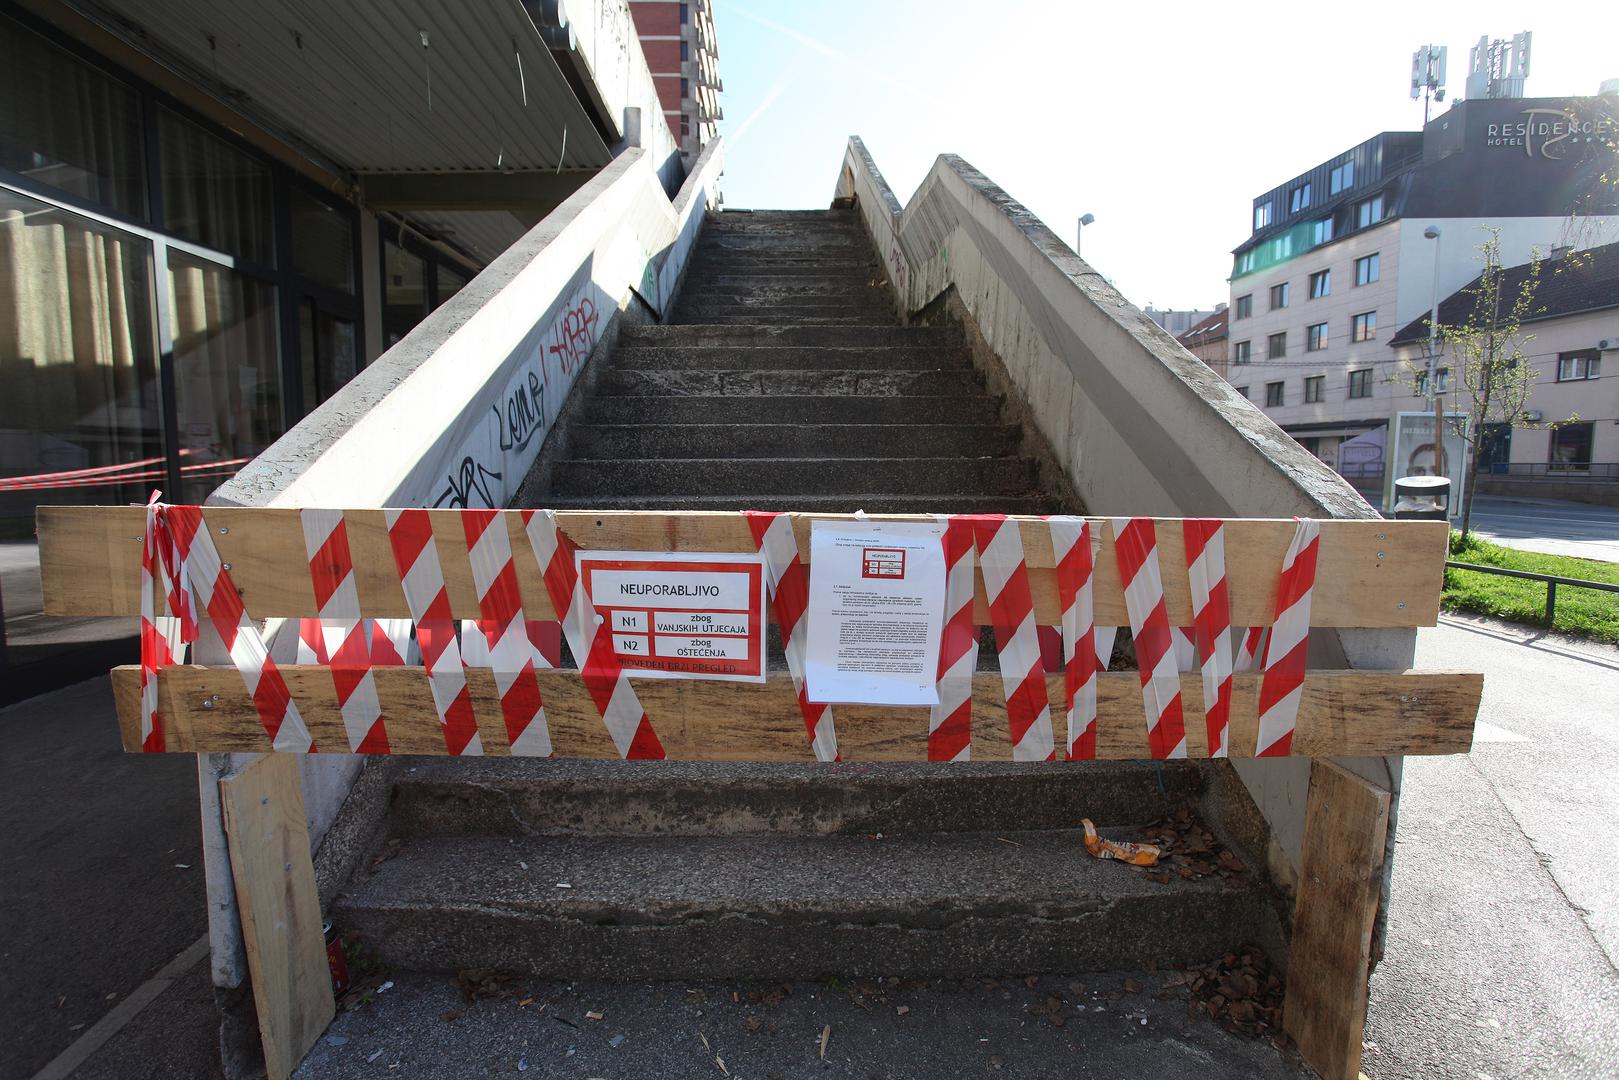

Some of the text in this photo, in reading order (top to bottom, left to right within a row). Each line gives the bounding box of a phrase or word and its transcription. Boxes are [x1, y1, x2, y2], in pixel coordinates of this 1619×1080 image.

[1488, 122, 1608, 137] RESIDENCE
[1488, 138, 1523, 146] HOTEL
[620, 584, 720, 597] NEUPORABLJIVO
[622, 616, 637, 627] N1
[690, 614, 712, 624] zbog
[657, 623, 746, 634] VANJSKIH UTJECAJA
[623, 640, 638, 651] N2
[690, 639, 712, 648] zbog
[676, 648, 726, 658] OŠTEĆENJA
[668, 662, 689, 671] BRZI
[692, 663, 736, 673] PREGLED
